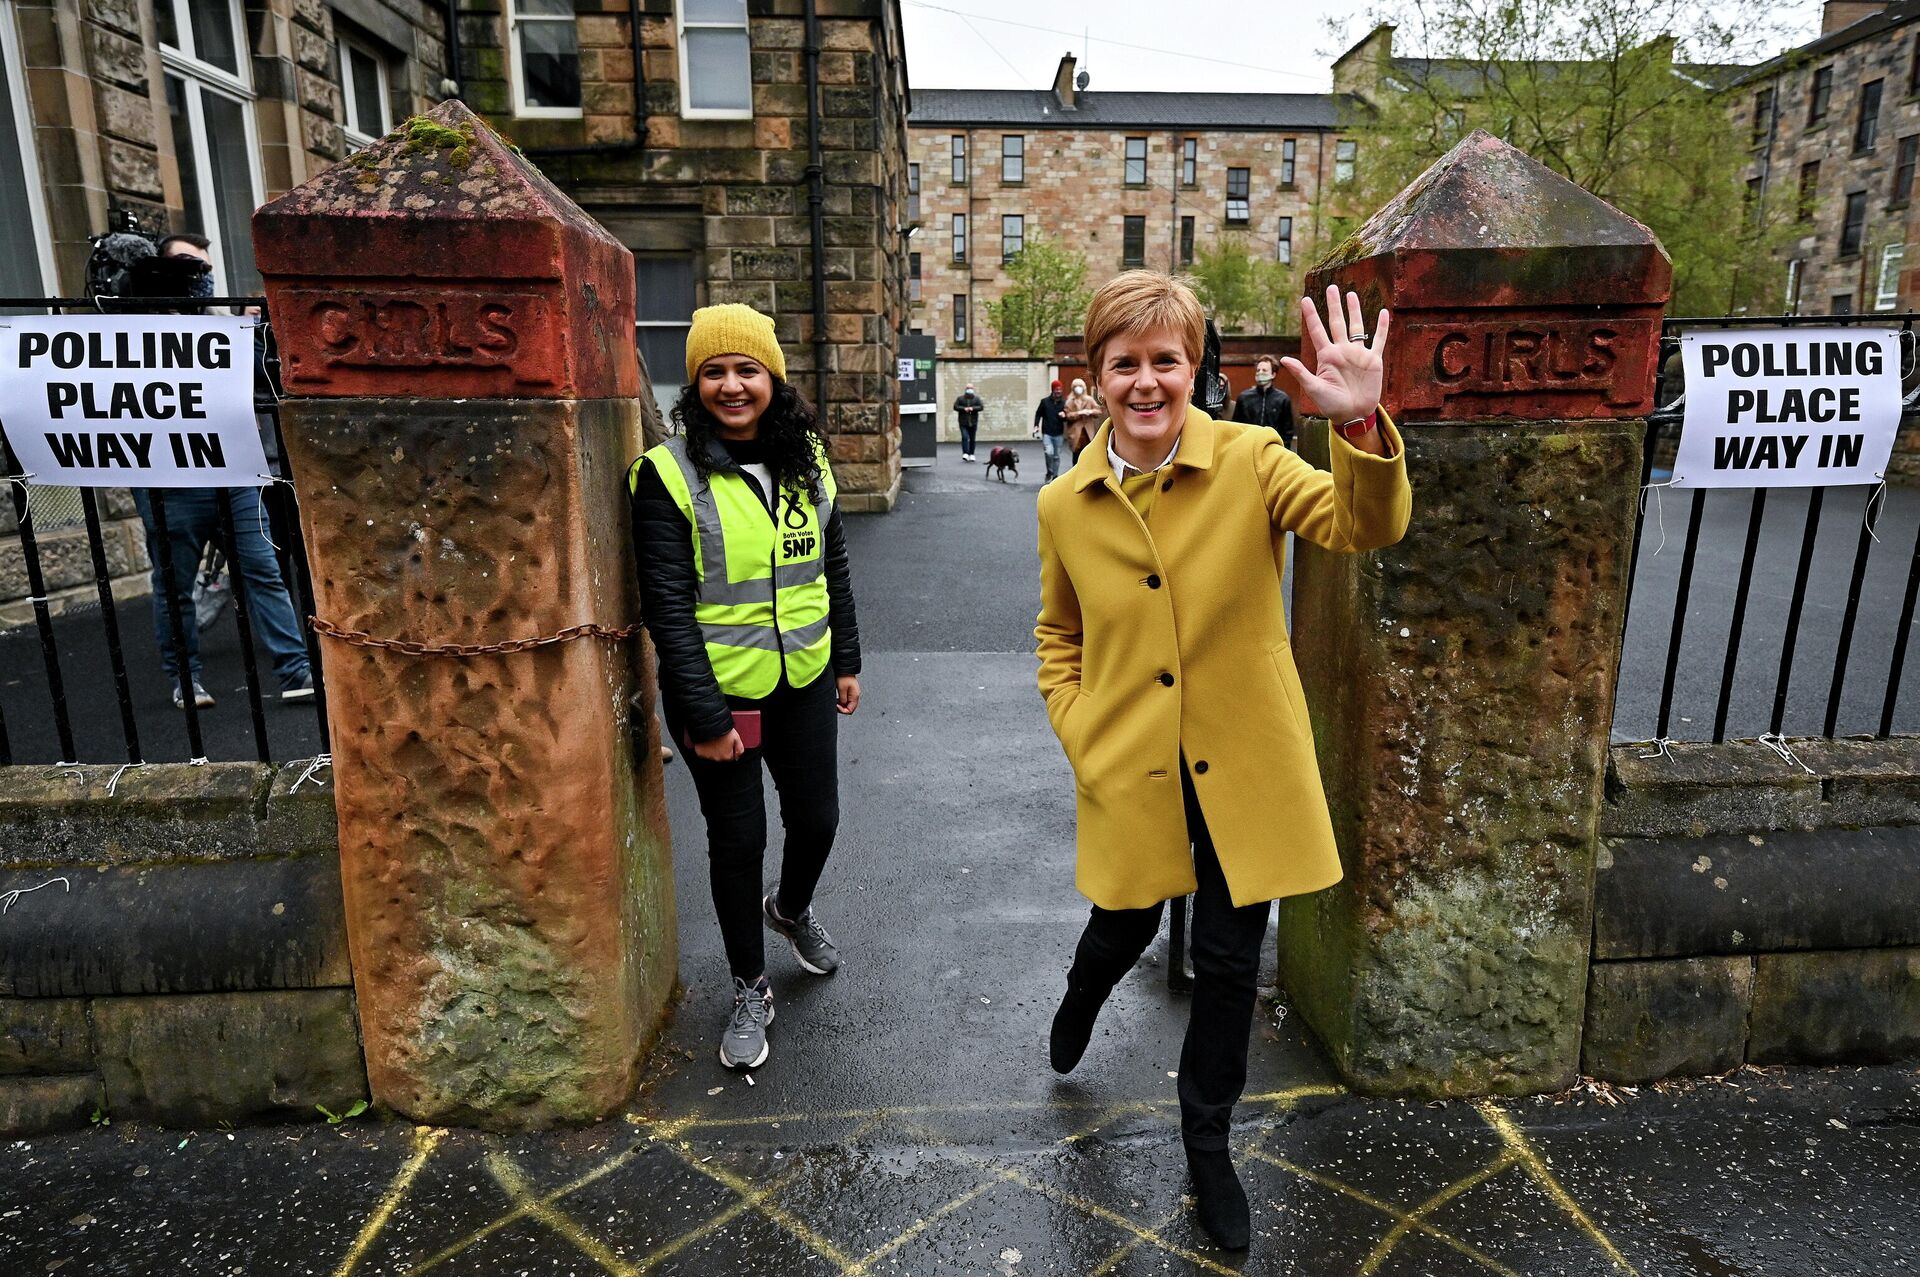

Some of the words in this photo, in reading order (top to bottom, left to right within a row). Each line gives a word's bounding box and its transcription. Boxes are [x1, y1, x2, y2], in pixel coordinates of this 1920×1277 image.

[18, 331, 231, 369] POLLING
[1701, 341, 1883, 377] POLLING
[46, 381, 207, 419] PLACE
[1727, 387, 1861, 423] PLACE
[44, 432, 153, 468] WAY
[168, 432, 226, 468] IN
[1713, 435, 1810, 470] WAY
[1817, 434, 1865, 468] IN
[783, 537, 816, 559] SNP
